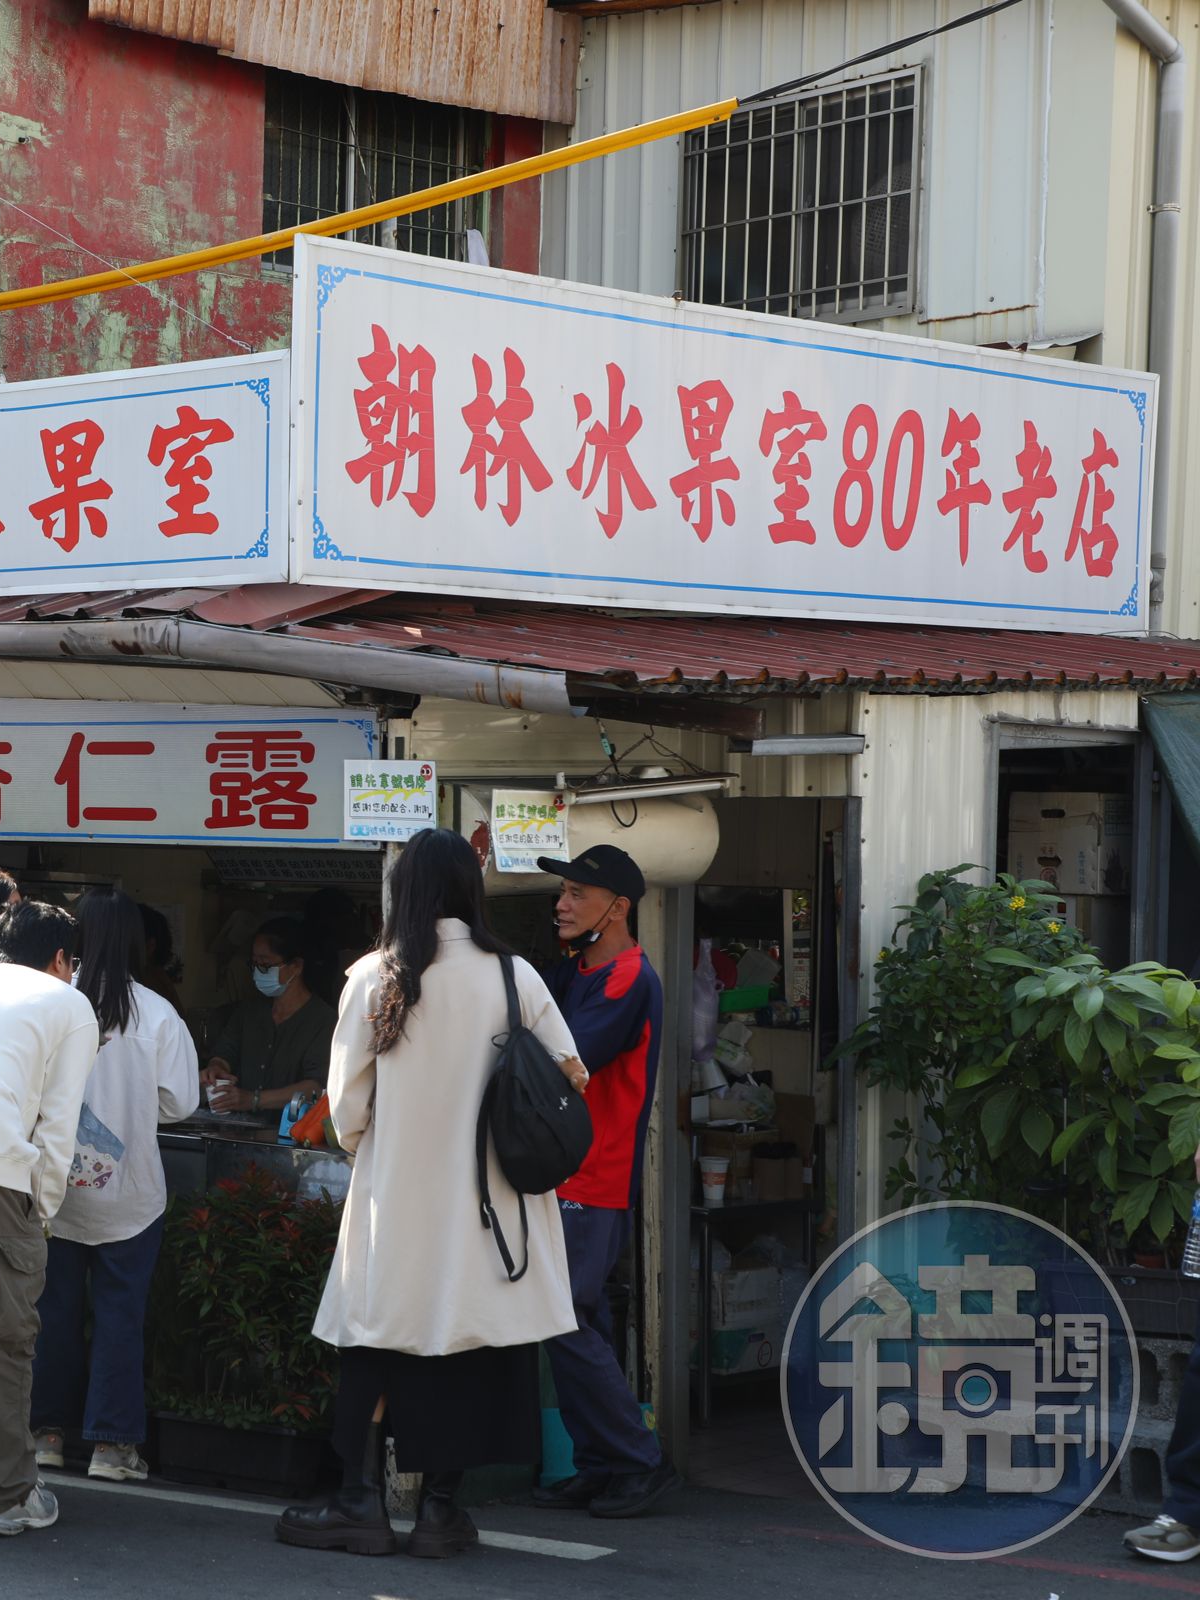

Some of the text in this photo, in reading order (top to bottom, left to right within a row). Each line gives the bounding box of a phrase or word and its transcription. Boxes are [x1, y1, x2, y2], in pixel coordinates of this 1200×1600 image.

[346, 324, 1118, 580] 朝林冰果室80年老店
